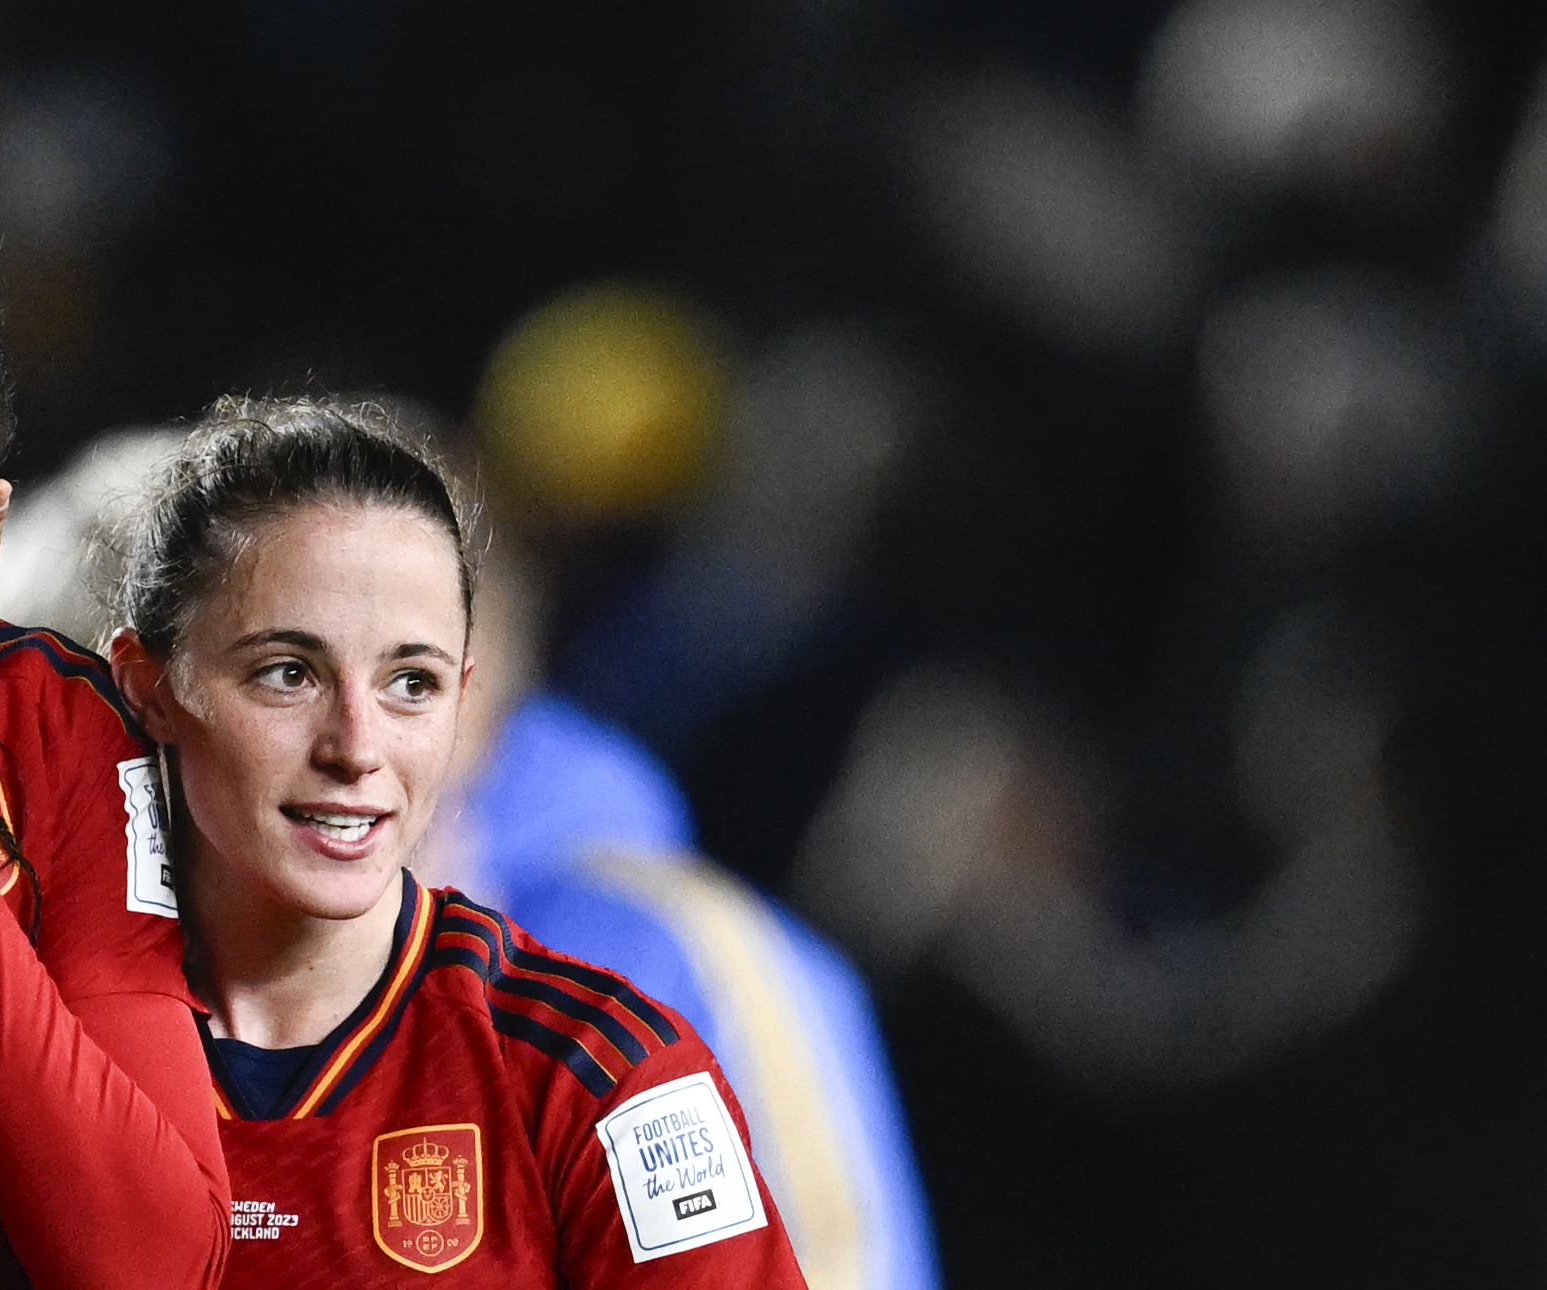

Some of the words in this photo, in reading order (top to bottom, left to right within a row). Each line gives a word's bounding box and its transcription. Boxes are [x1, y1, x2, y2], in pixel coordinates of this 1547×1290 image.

[633, 1106, 706, 1145] FOOTBALL
[639, 1127, 714, 1173] UNITES
[642, 1174, 676, 1199] the
[676, 1154, 726, 1189] World
[267, 1214, 299, 1227] 2023
[678, 1194, 713, 1215] FIFA
